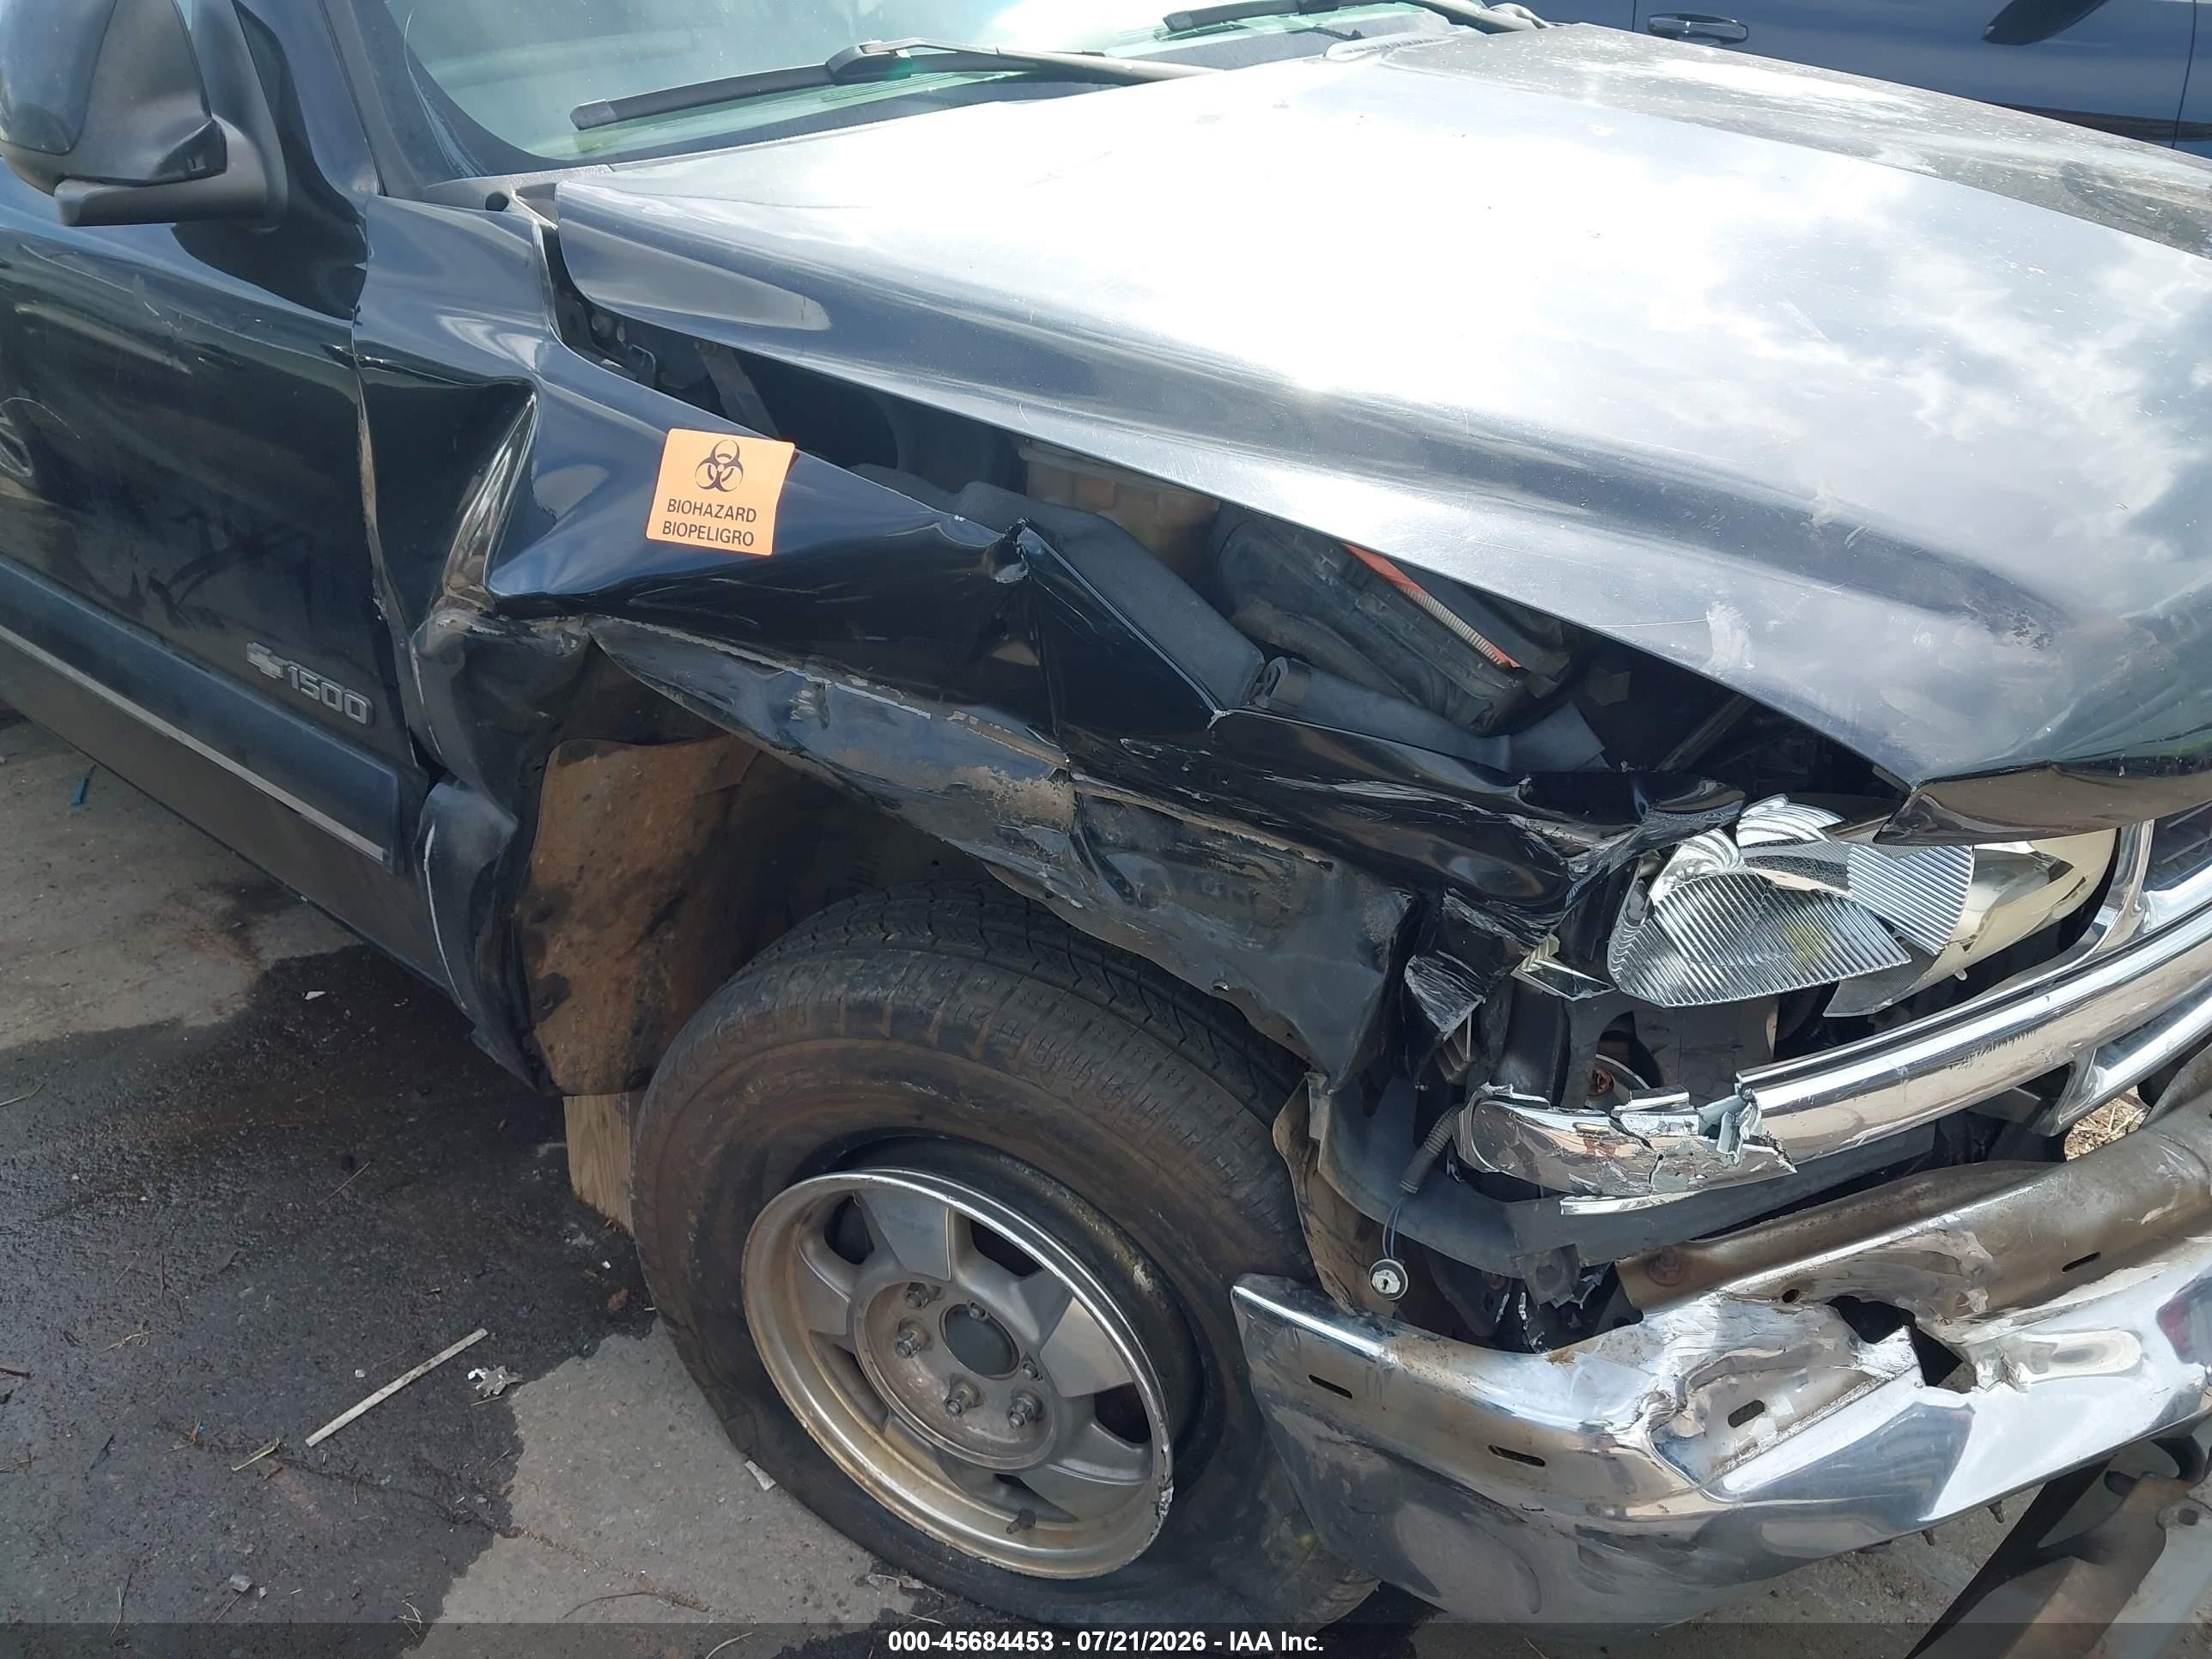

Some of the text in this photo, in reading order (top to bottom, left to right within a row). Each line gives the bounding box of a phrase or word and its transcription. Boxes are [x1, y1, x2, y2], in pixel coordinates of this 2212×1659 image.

[666, 498, 757, 523] BIOHAZARD
[661, 520, 755, 547] BIOPELIGRO
[288, 663, 368, 725] 1500
